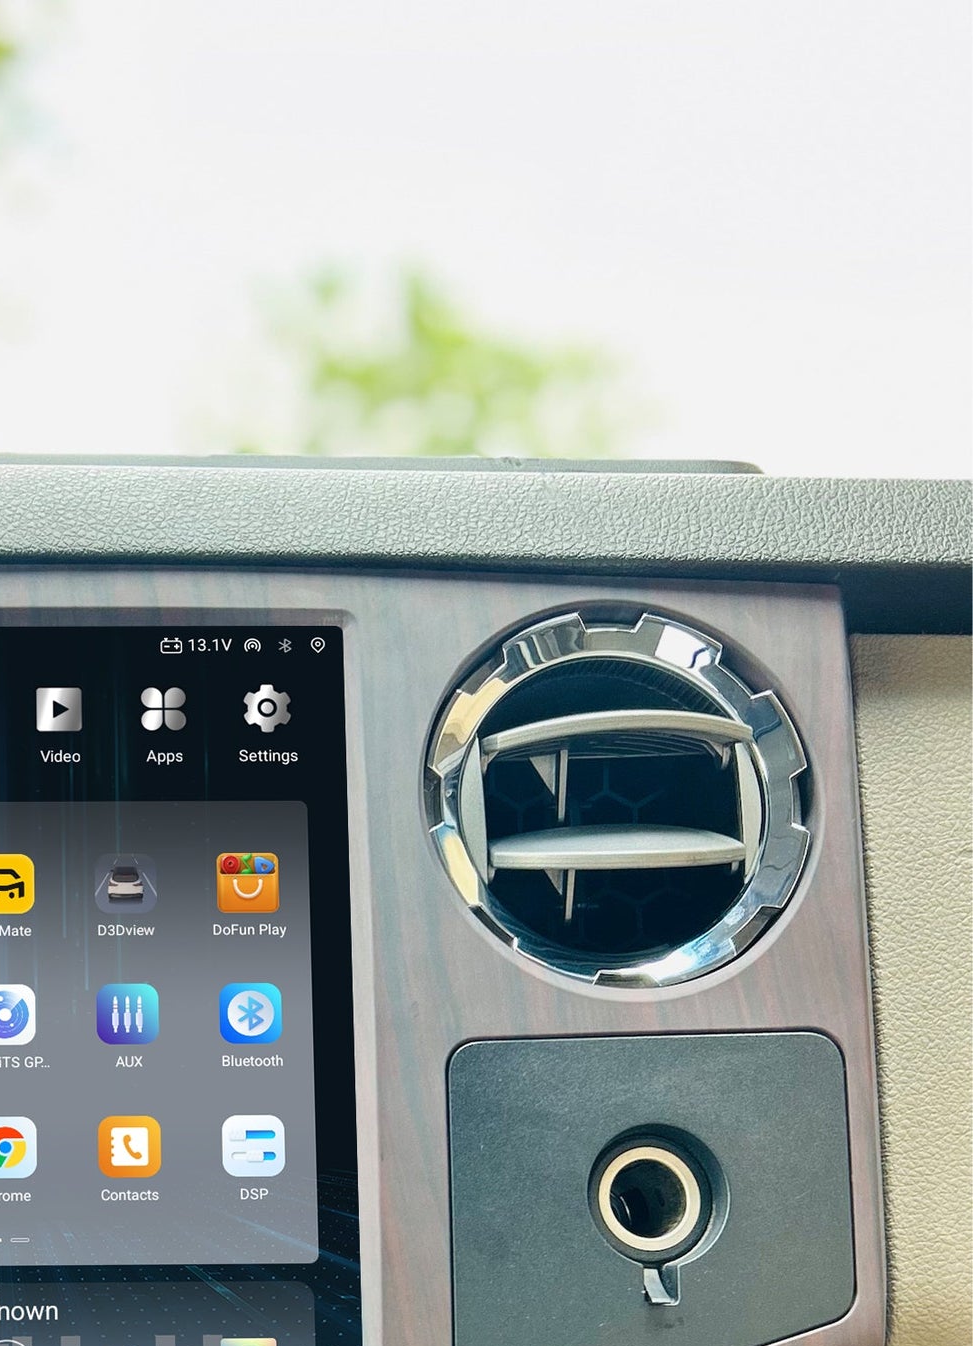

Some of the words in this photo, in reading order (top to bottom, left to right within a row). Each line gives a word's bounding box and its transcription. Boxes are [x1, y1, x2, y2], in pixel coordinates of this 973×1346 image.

[187, 639, 232, 651] 13.1V
[39, 750, 80, 762] Video
[146, 750, 182, 765] Apps
[238, 750, 298, 765] Settings
[97, 925, 154, 935] D3Dview
[213, 924, 255, 935] DoFun
[259, 924, 287, 938] Play
[115, 1056, 142, 1067] AUX
[221, 1055, 283, 1066] Bluetooth
[100, 1189, 159, 1201] Contacts
[240, 1188, 268, 1200] DSP
